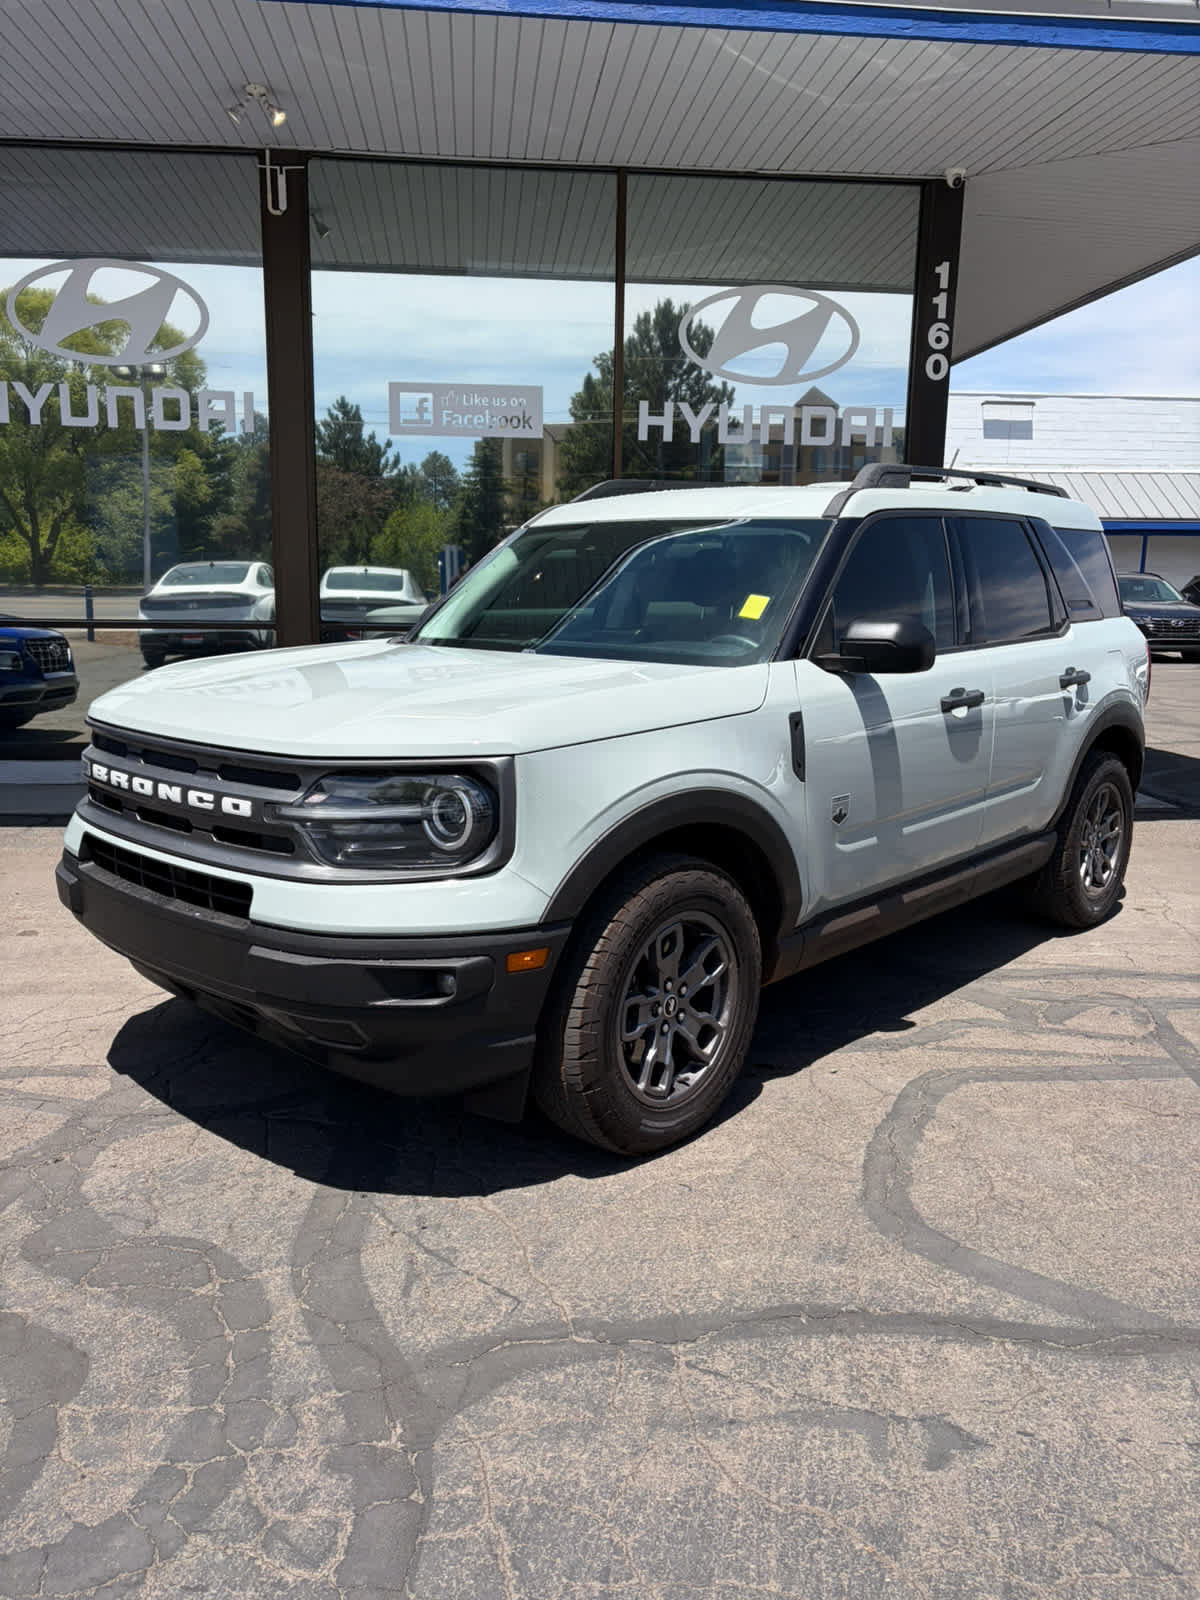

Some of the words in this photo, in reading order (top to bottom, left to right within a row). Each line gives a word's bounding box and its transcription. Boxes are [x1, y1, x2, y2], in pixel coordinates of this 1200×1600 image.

[925, 261, 950, 381] 1160
[0, 381, 254, 433] YUNDAI
[463, 393, 489, 408] Like
[492, 397, 507, 407] us
[510, 398, 527, 408] on
[638, 400, 893, 448] HYUNDAI
[92, 763, 253, 818] BRONCO
